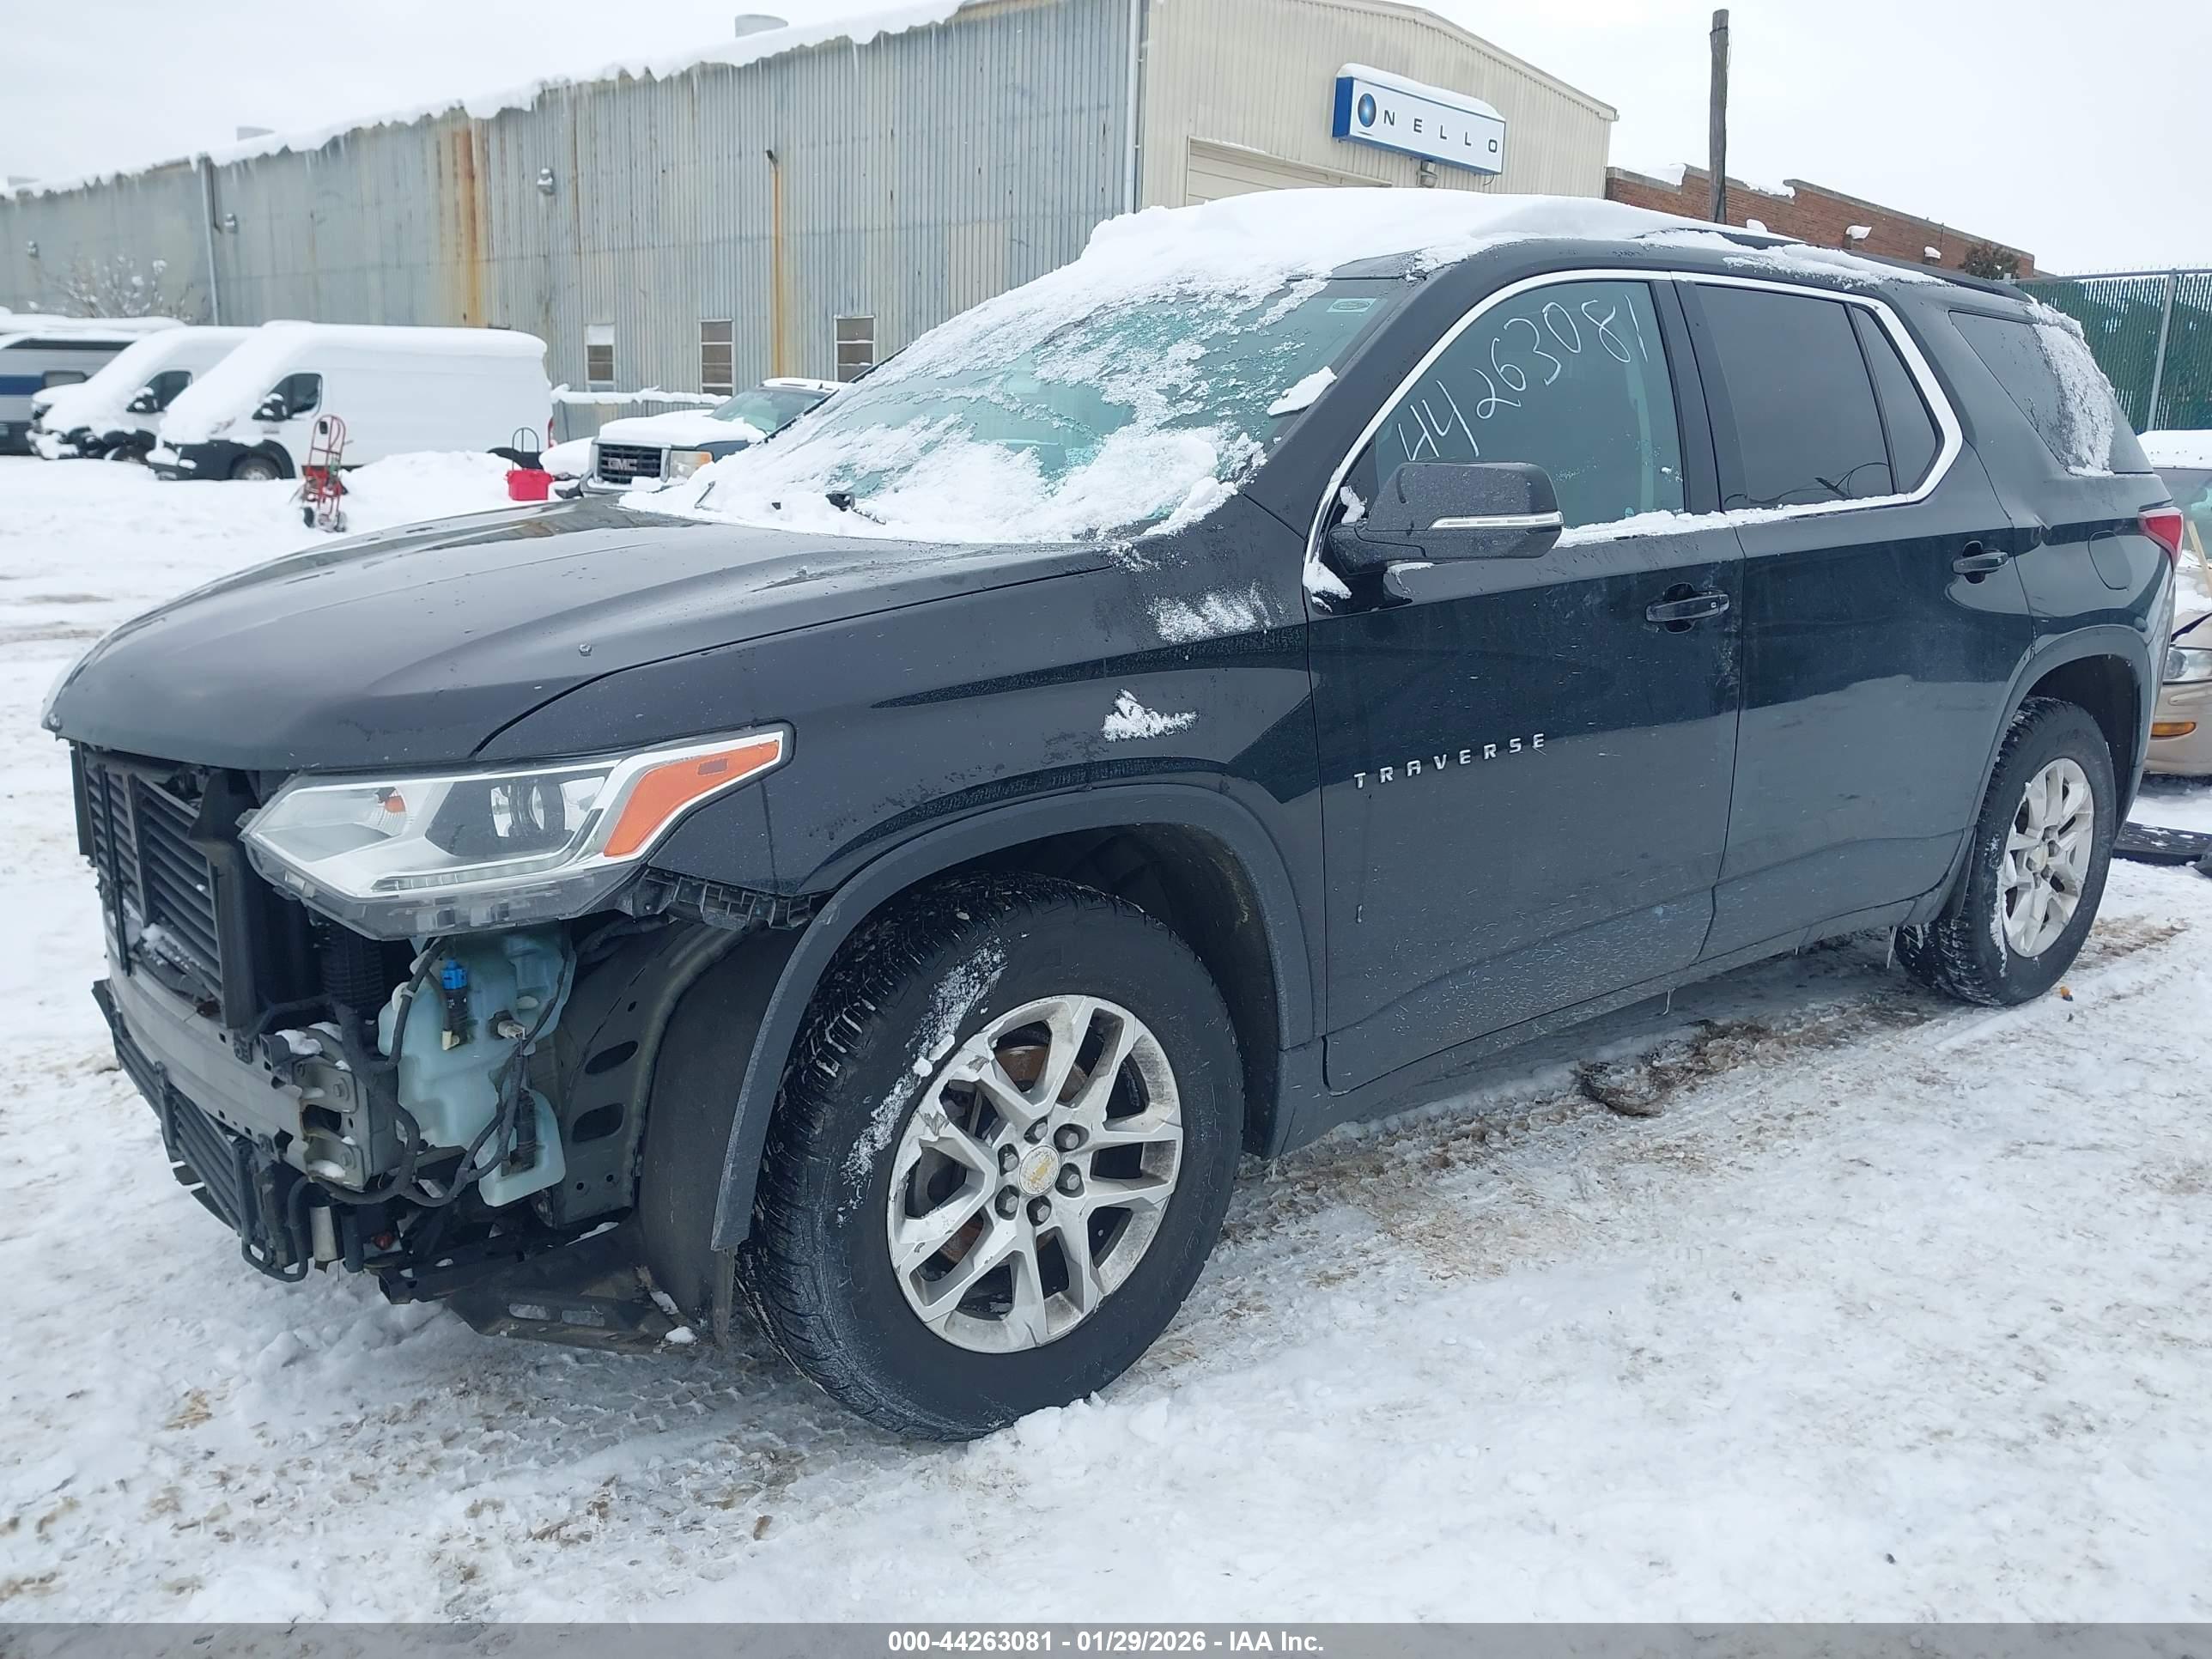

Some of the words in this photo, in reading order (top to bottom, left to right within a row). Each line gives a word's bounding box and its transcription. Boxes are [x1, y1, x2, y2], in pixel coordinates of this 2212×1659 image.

[1397, 294, 1649, 462] 44263081
[607, 457, 638, 471] GMC
[1353, 732, 1545, 789] TRAVERSE
